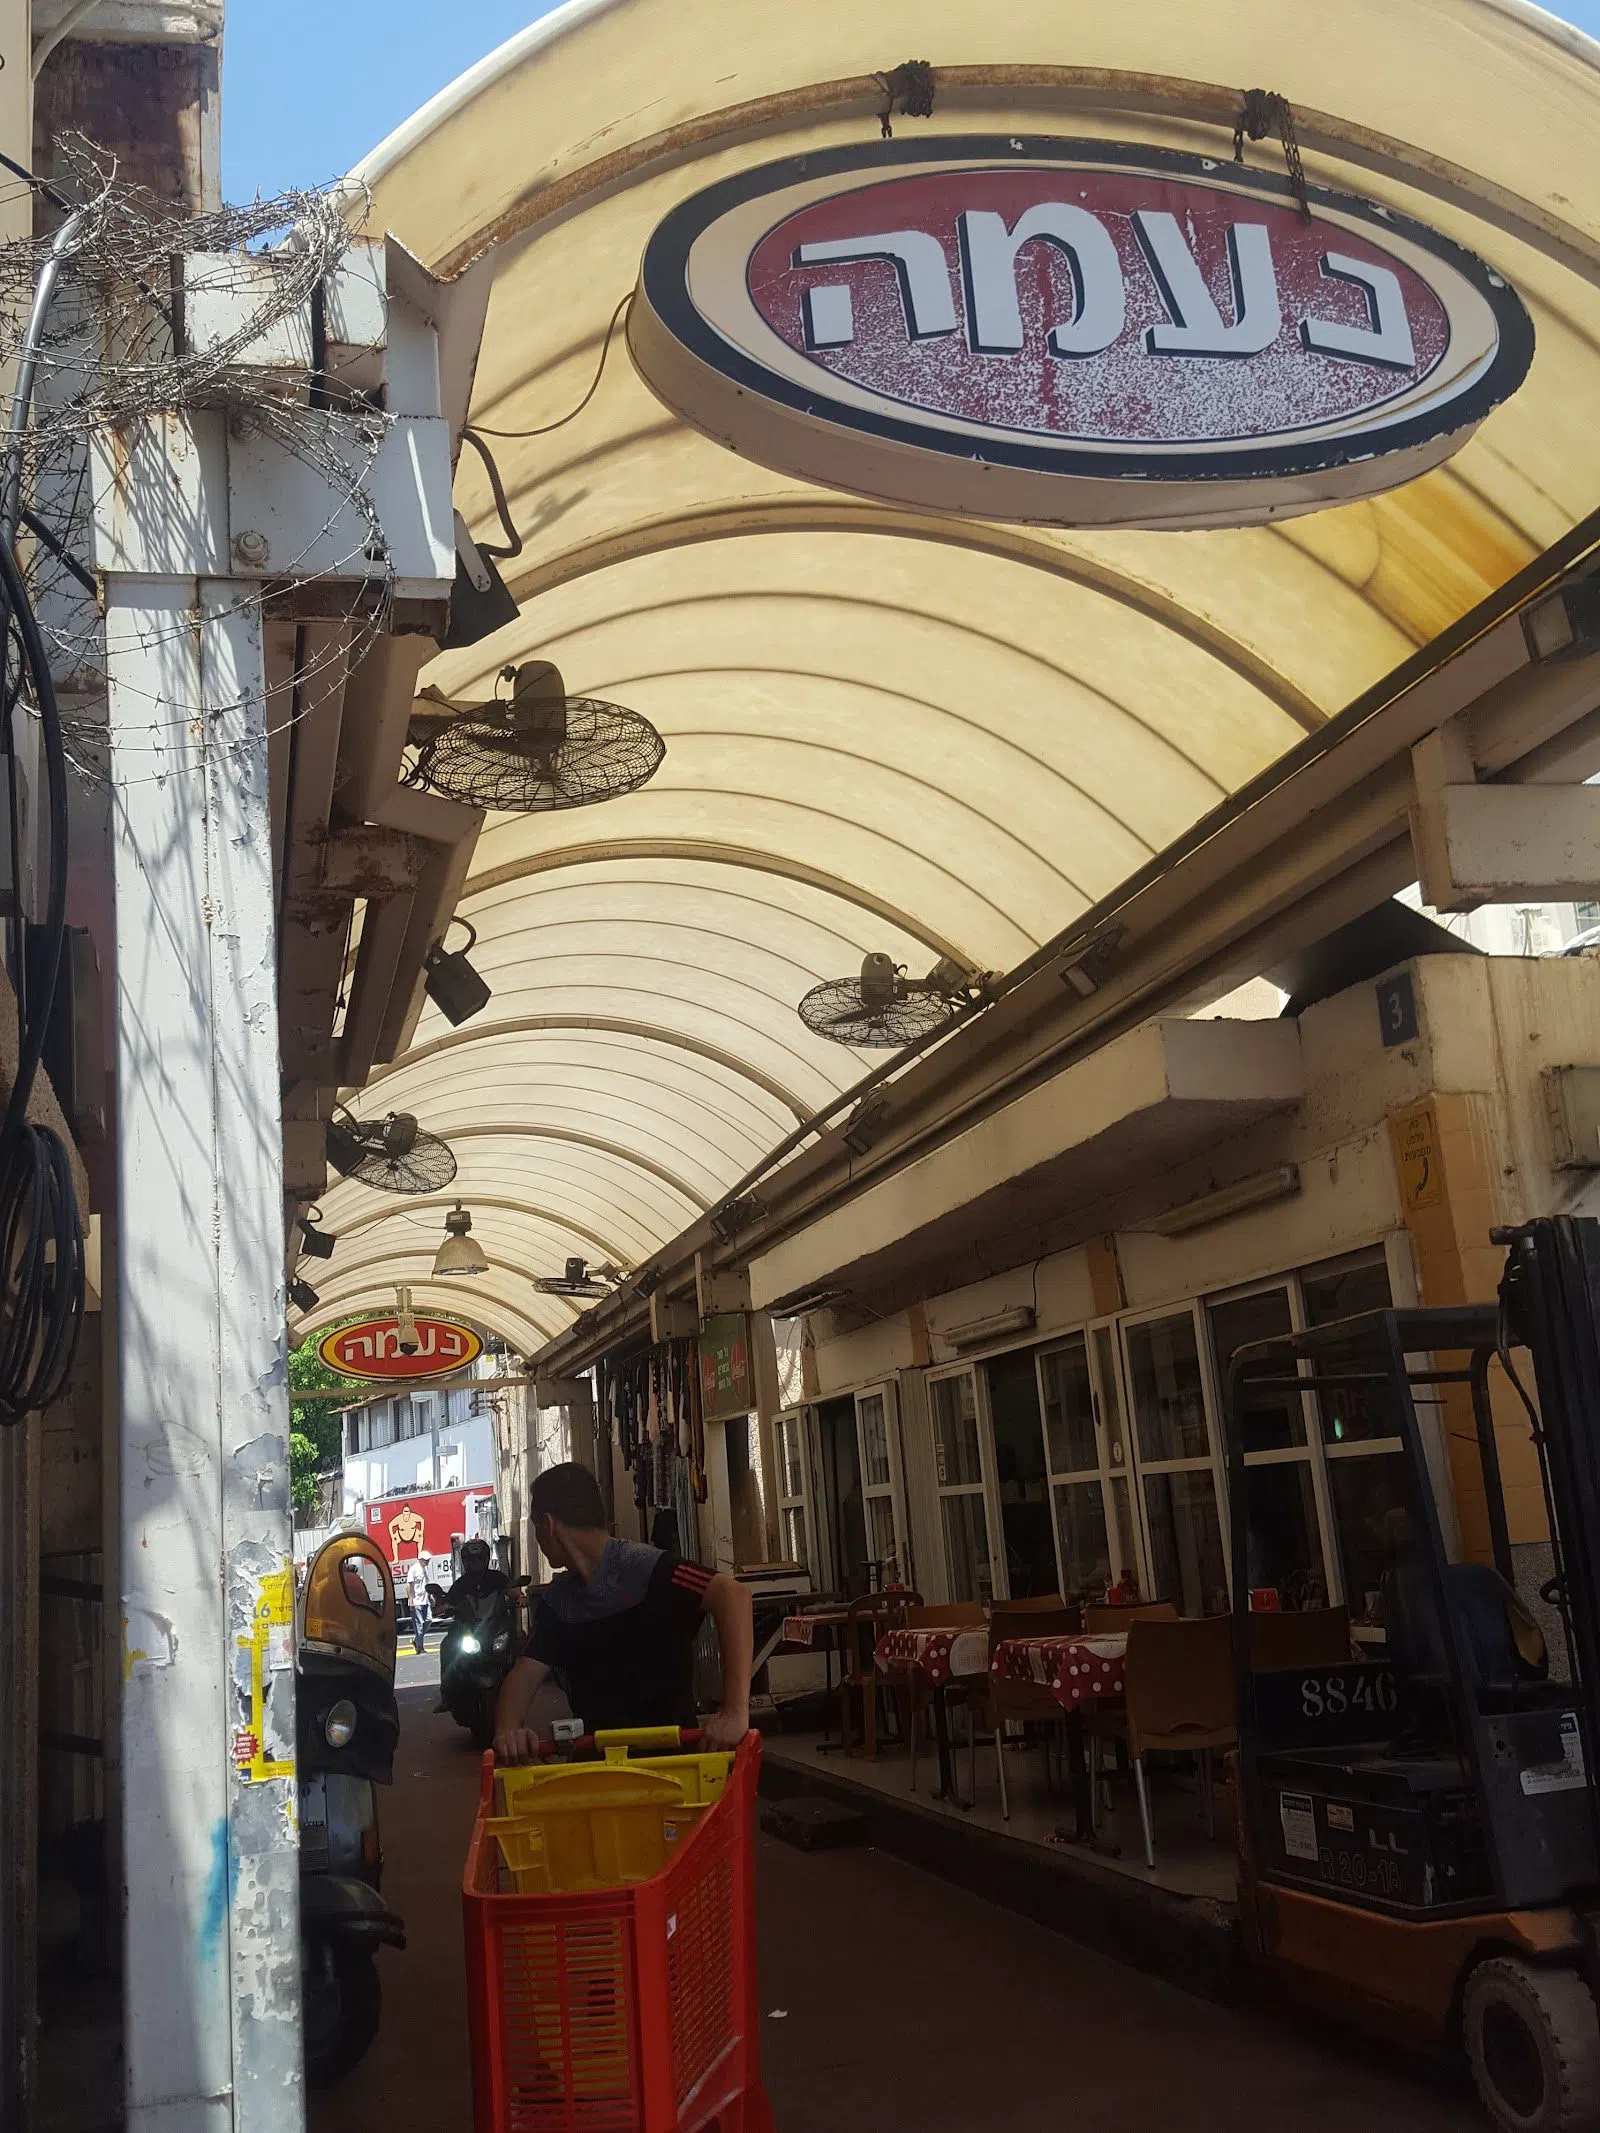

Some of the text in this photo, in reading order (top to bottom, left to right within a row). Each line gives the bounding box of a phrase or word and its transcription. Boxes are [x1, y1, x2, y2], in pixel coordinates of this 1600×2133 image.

[790, 201, 1417, 372] נעמה
[1387, 992, 1404, 1031] 3
[1301, 1672, 1399, 1717] 8846
